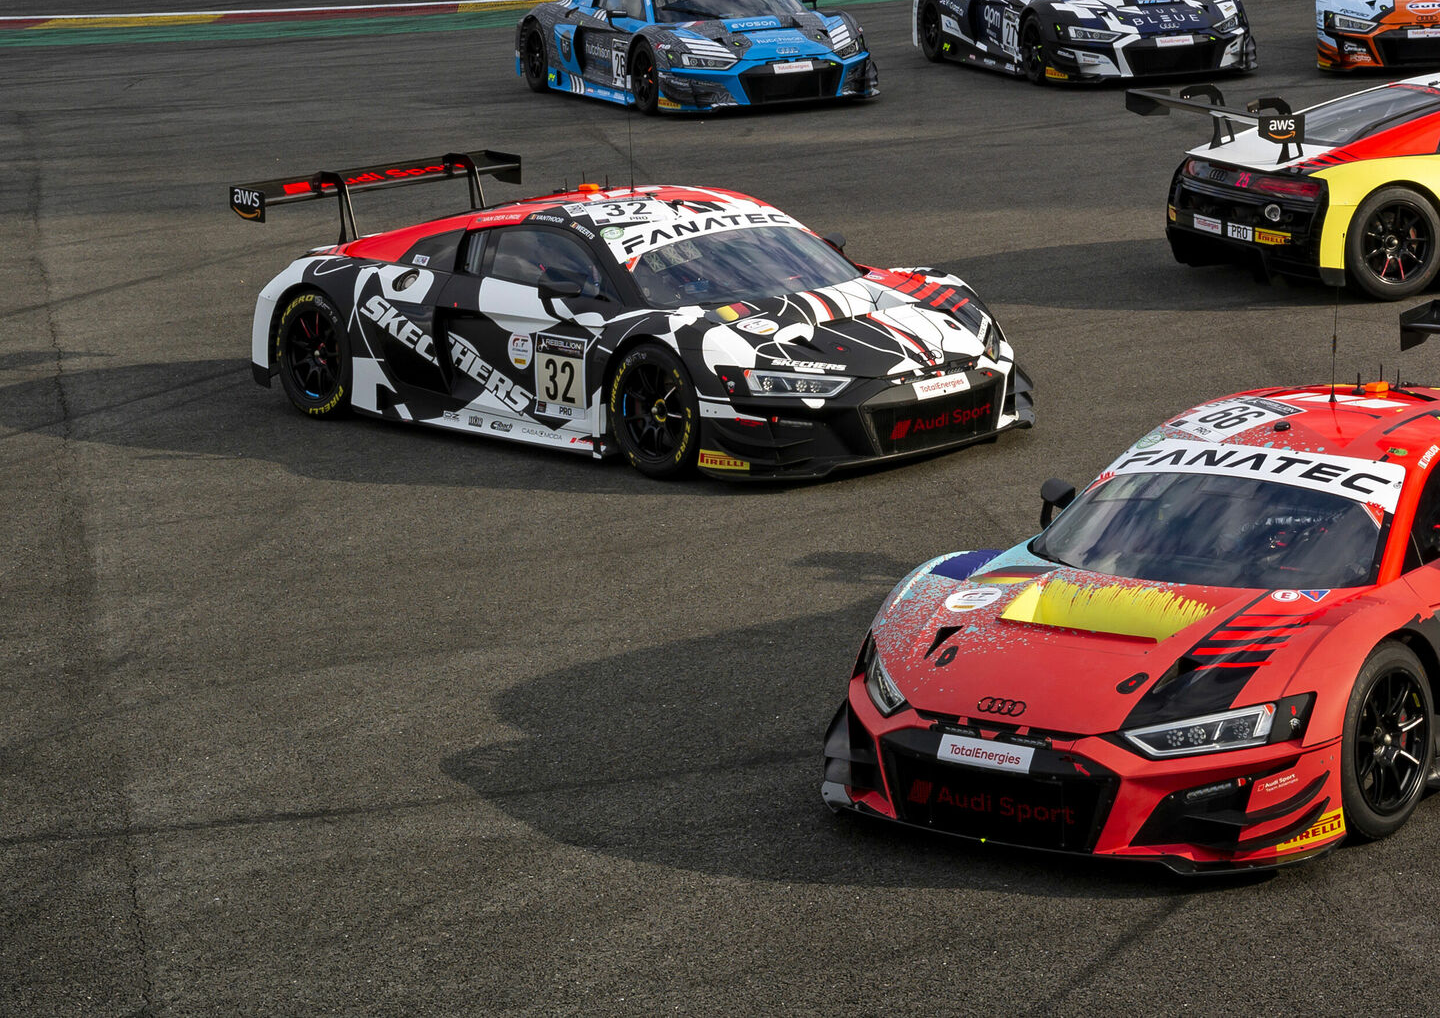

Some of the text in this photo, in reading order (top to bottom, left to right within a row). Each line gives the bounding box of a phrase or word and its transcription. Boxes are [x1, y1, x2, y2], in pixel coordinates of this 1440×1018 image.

[1132, 13, 1200, 26] BLEUE
[1268, 118, 1296, 133] aws
[1235, 172, 1252, 188] 25
[233, 187, 260, 208] aws
[536, 214, 564, 224] VANTHOOR
[602, 202, 652, 218] 32
[575, 224, 596, 240] WEERTS
[621, 212, 792, 256] FANATEC
[1231, 225, 1248, 239] PRO
[359, 294, 535, 415] SKECHERS
[770, 358, 847, 371] SKECHERS
[544, 358, 576, 404] 32
[610, 361, 628, 413] PIRELLI
[919, 377, 965, 394] TotalEnergies
[308, 385, 344, 415] PIRELLI
[558, 406, 573, 416] PRO
[912, 402, 992, 435] Audi Sport
[1198, 405, 1266, 430] 66
[700, 453, 744, 468] PIRELLI
[1424, 444, 1440, 463] DRUDI
[1115, 448, 1392, 495] FANATEC
[949, 743, 1022, 766] TotalEnergies
[1264, 773, 1296, 788] Audi Sport
[936, 785, 1075, 825] Audi Sport
